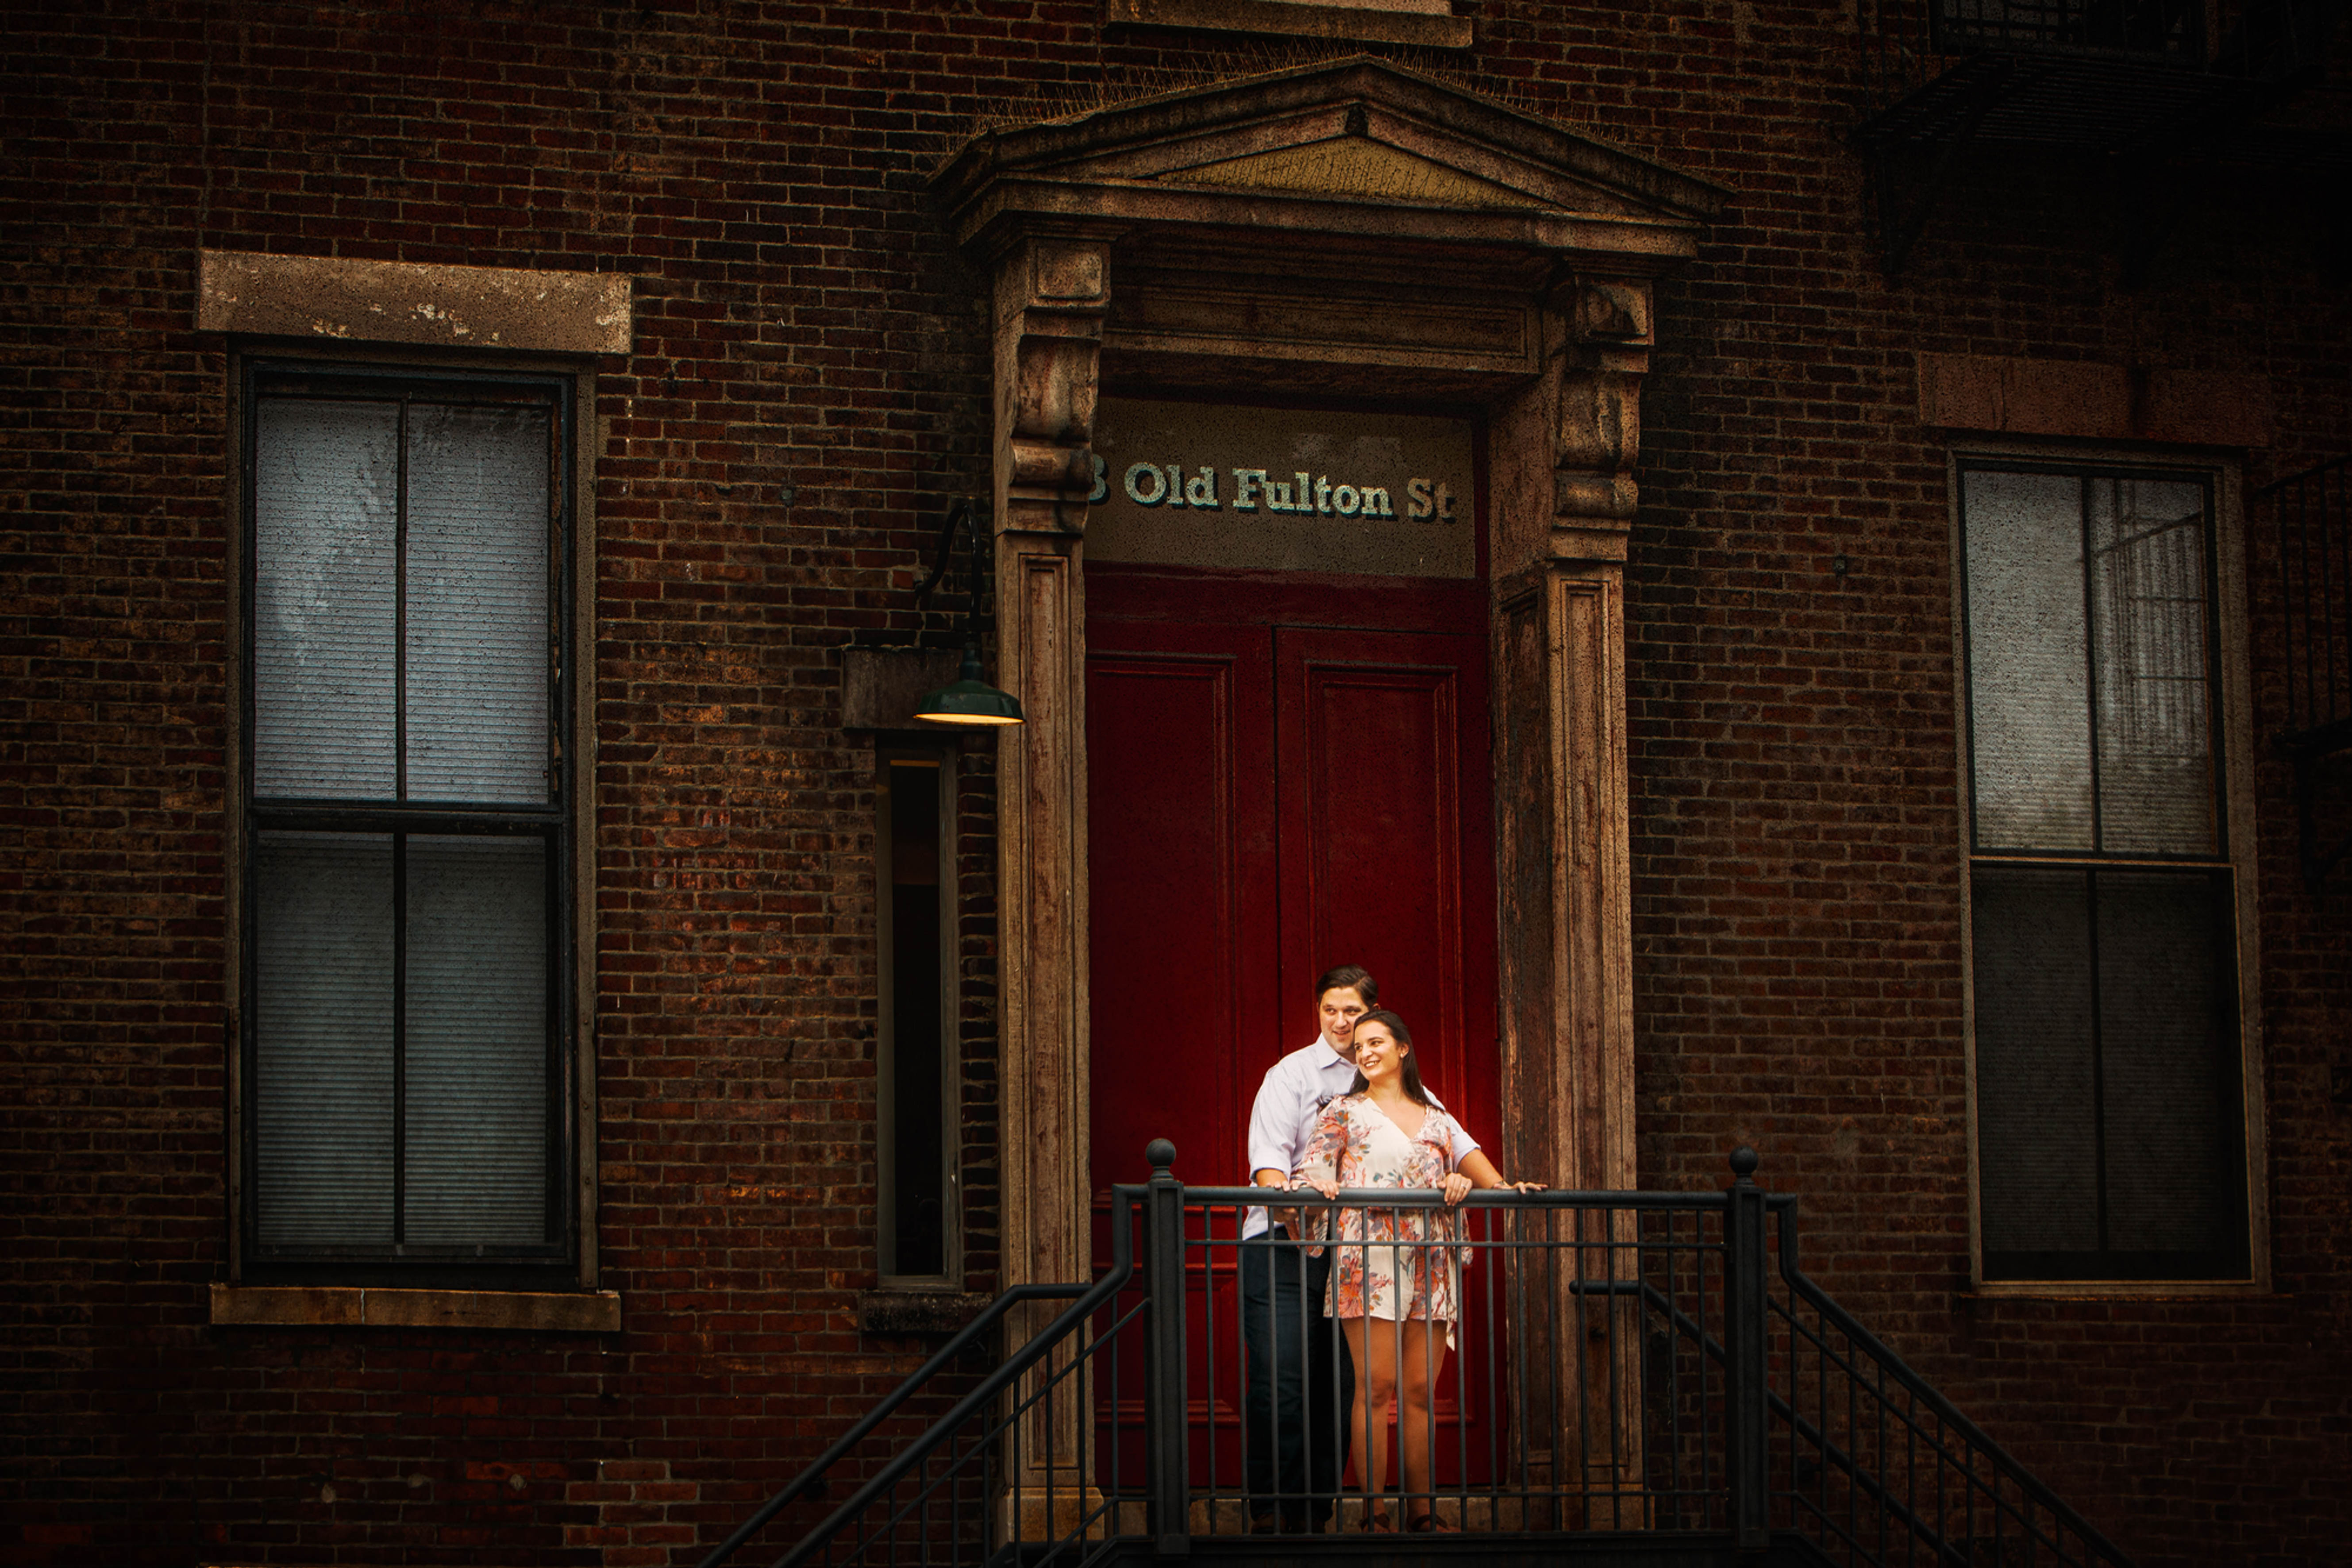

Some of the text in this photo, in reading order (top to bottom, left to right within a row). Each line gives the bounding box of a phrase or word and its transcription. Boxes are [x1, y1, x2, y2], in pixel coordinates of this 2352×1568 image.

[1124, 461, 1220, 508] Old
[1232, 468, 1395, 517] Fulton
[1407, 477, 1455, 520] St
